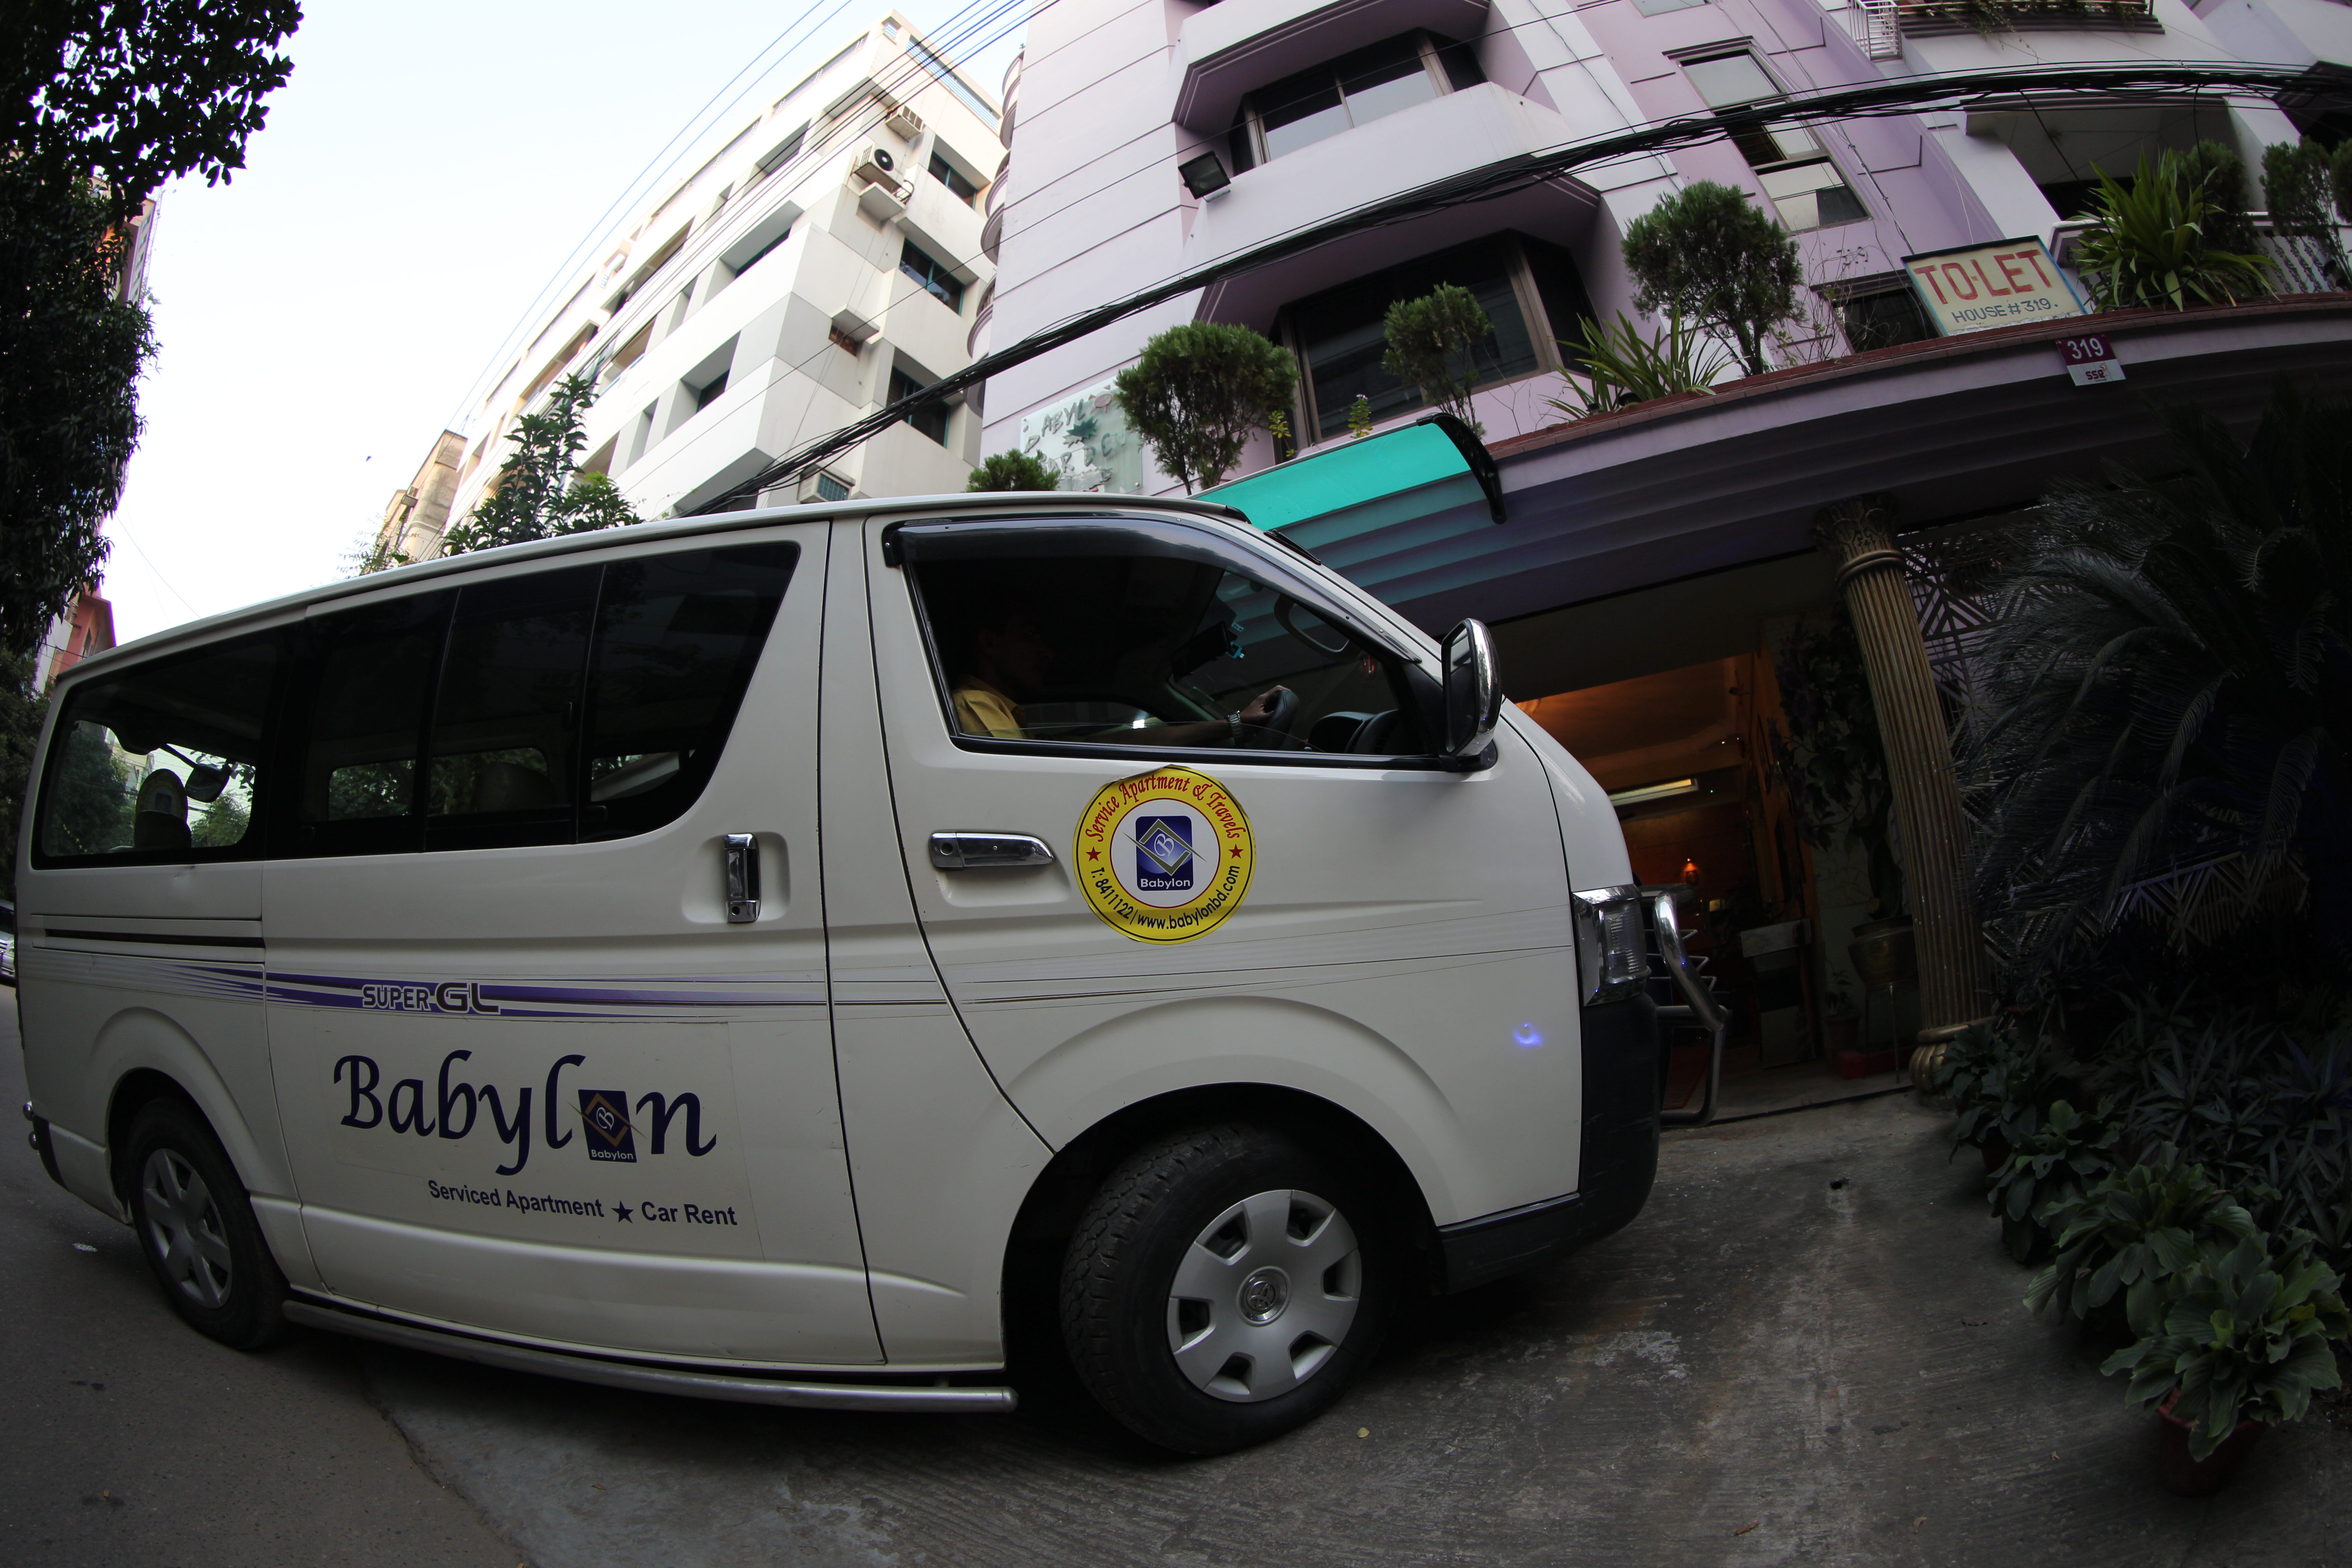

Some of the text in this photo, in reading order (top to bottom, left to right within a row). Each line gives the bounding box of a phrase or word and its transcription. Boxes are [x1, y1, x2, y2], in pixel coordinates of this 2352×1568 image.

[1913, 249, 2053, 305] TO-LET
[1951, 305, 2007, 323] HOUSE
[2067, 338, 2104, 359] 319
[1085, 774, 1246, 842] Service Apartment & Travels
[1091, 867, 1105, 879] T:
[1140, 878, 1190, 889] Babylon
[362, 982, 501, 1015] SUPER GL
[591, 1149, 633, 1160] Babylon
[428, 1180, 737, 1226] Serviced Apartment Car Rent
